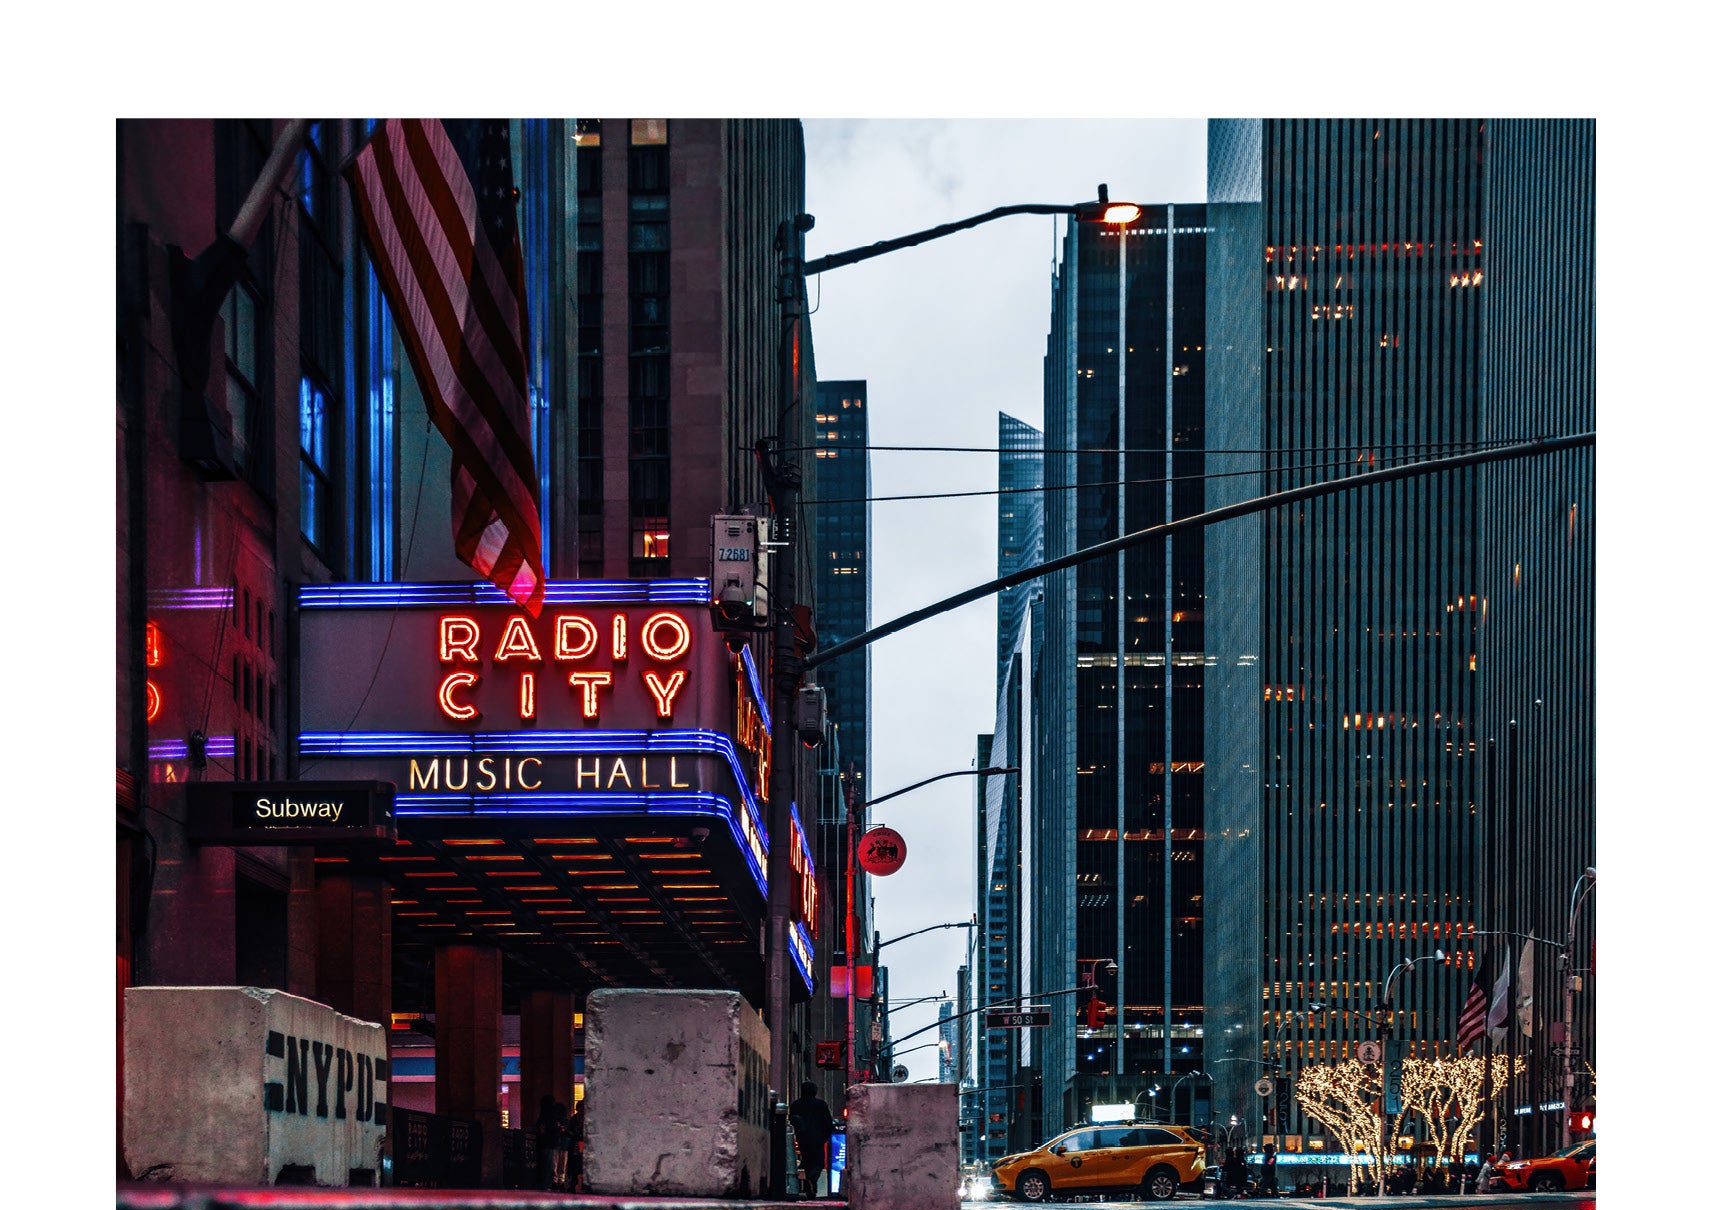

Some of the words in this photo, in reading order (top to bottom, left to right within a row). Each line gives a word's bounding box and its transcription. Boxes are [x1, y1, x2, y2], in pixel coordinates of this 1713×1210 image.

[440, 611, 691, 662] RADIO
[439, 670, 688, 720] CITY
[409, 757, 543, 790] MUSIC
[576, 756, 690, 789] HALL
[255, 798, 345, 822] Subway
[1002, 1016, 1010, 1025] W
[1012, 1015, 1023, 1025] 50
[1025, 1015, 1034, 1024] St
[286, 1035, 374, 1122] NYPD
